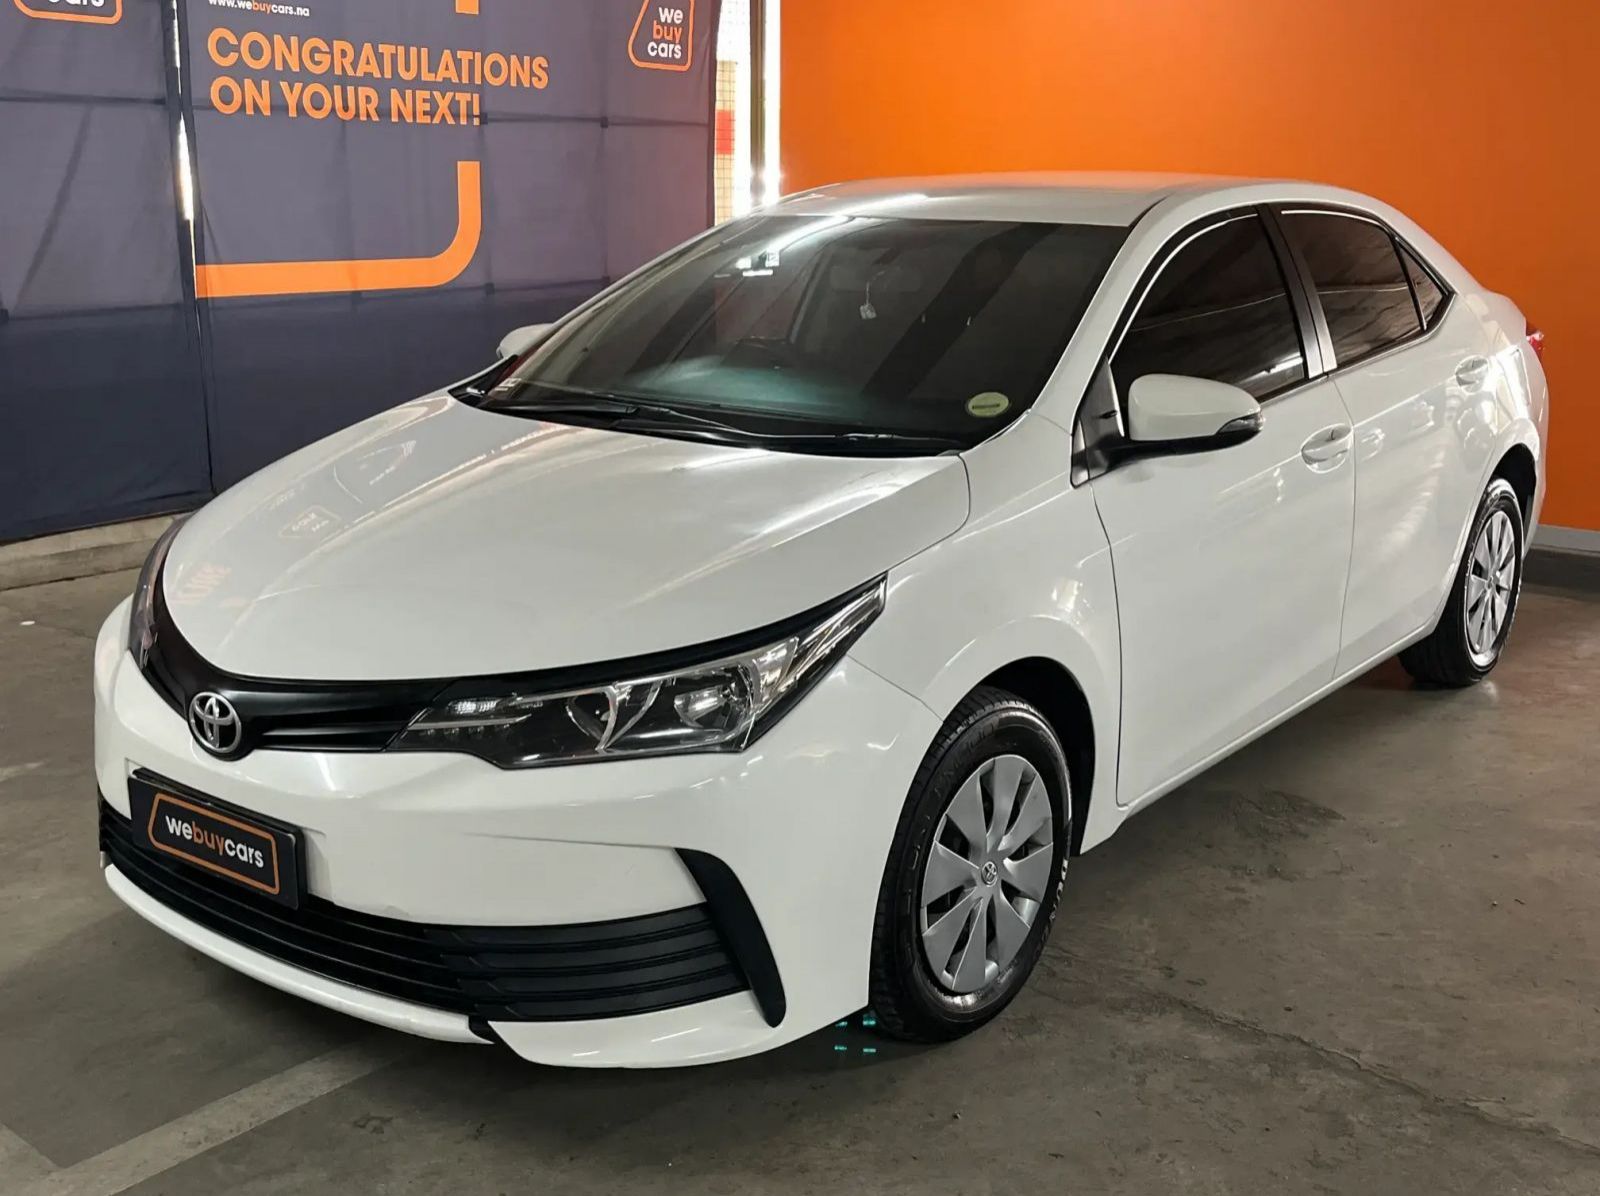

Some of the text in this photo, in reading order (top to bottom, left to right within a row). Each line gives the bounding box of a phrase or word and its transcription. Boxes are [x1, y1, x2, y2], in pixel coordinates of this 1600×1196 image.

[653, 20, 682, 44] buy
[658, 7, 683, 24] we
[207, 27, 550, 90] CONGRATULATIONS
[647, 41, 682, 59] cars
[210, 75, 481, 127] ON YOUR NEXT!
[165, 815, 264, 868] webuycars
